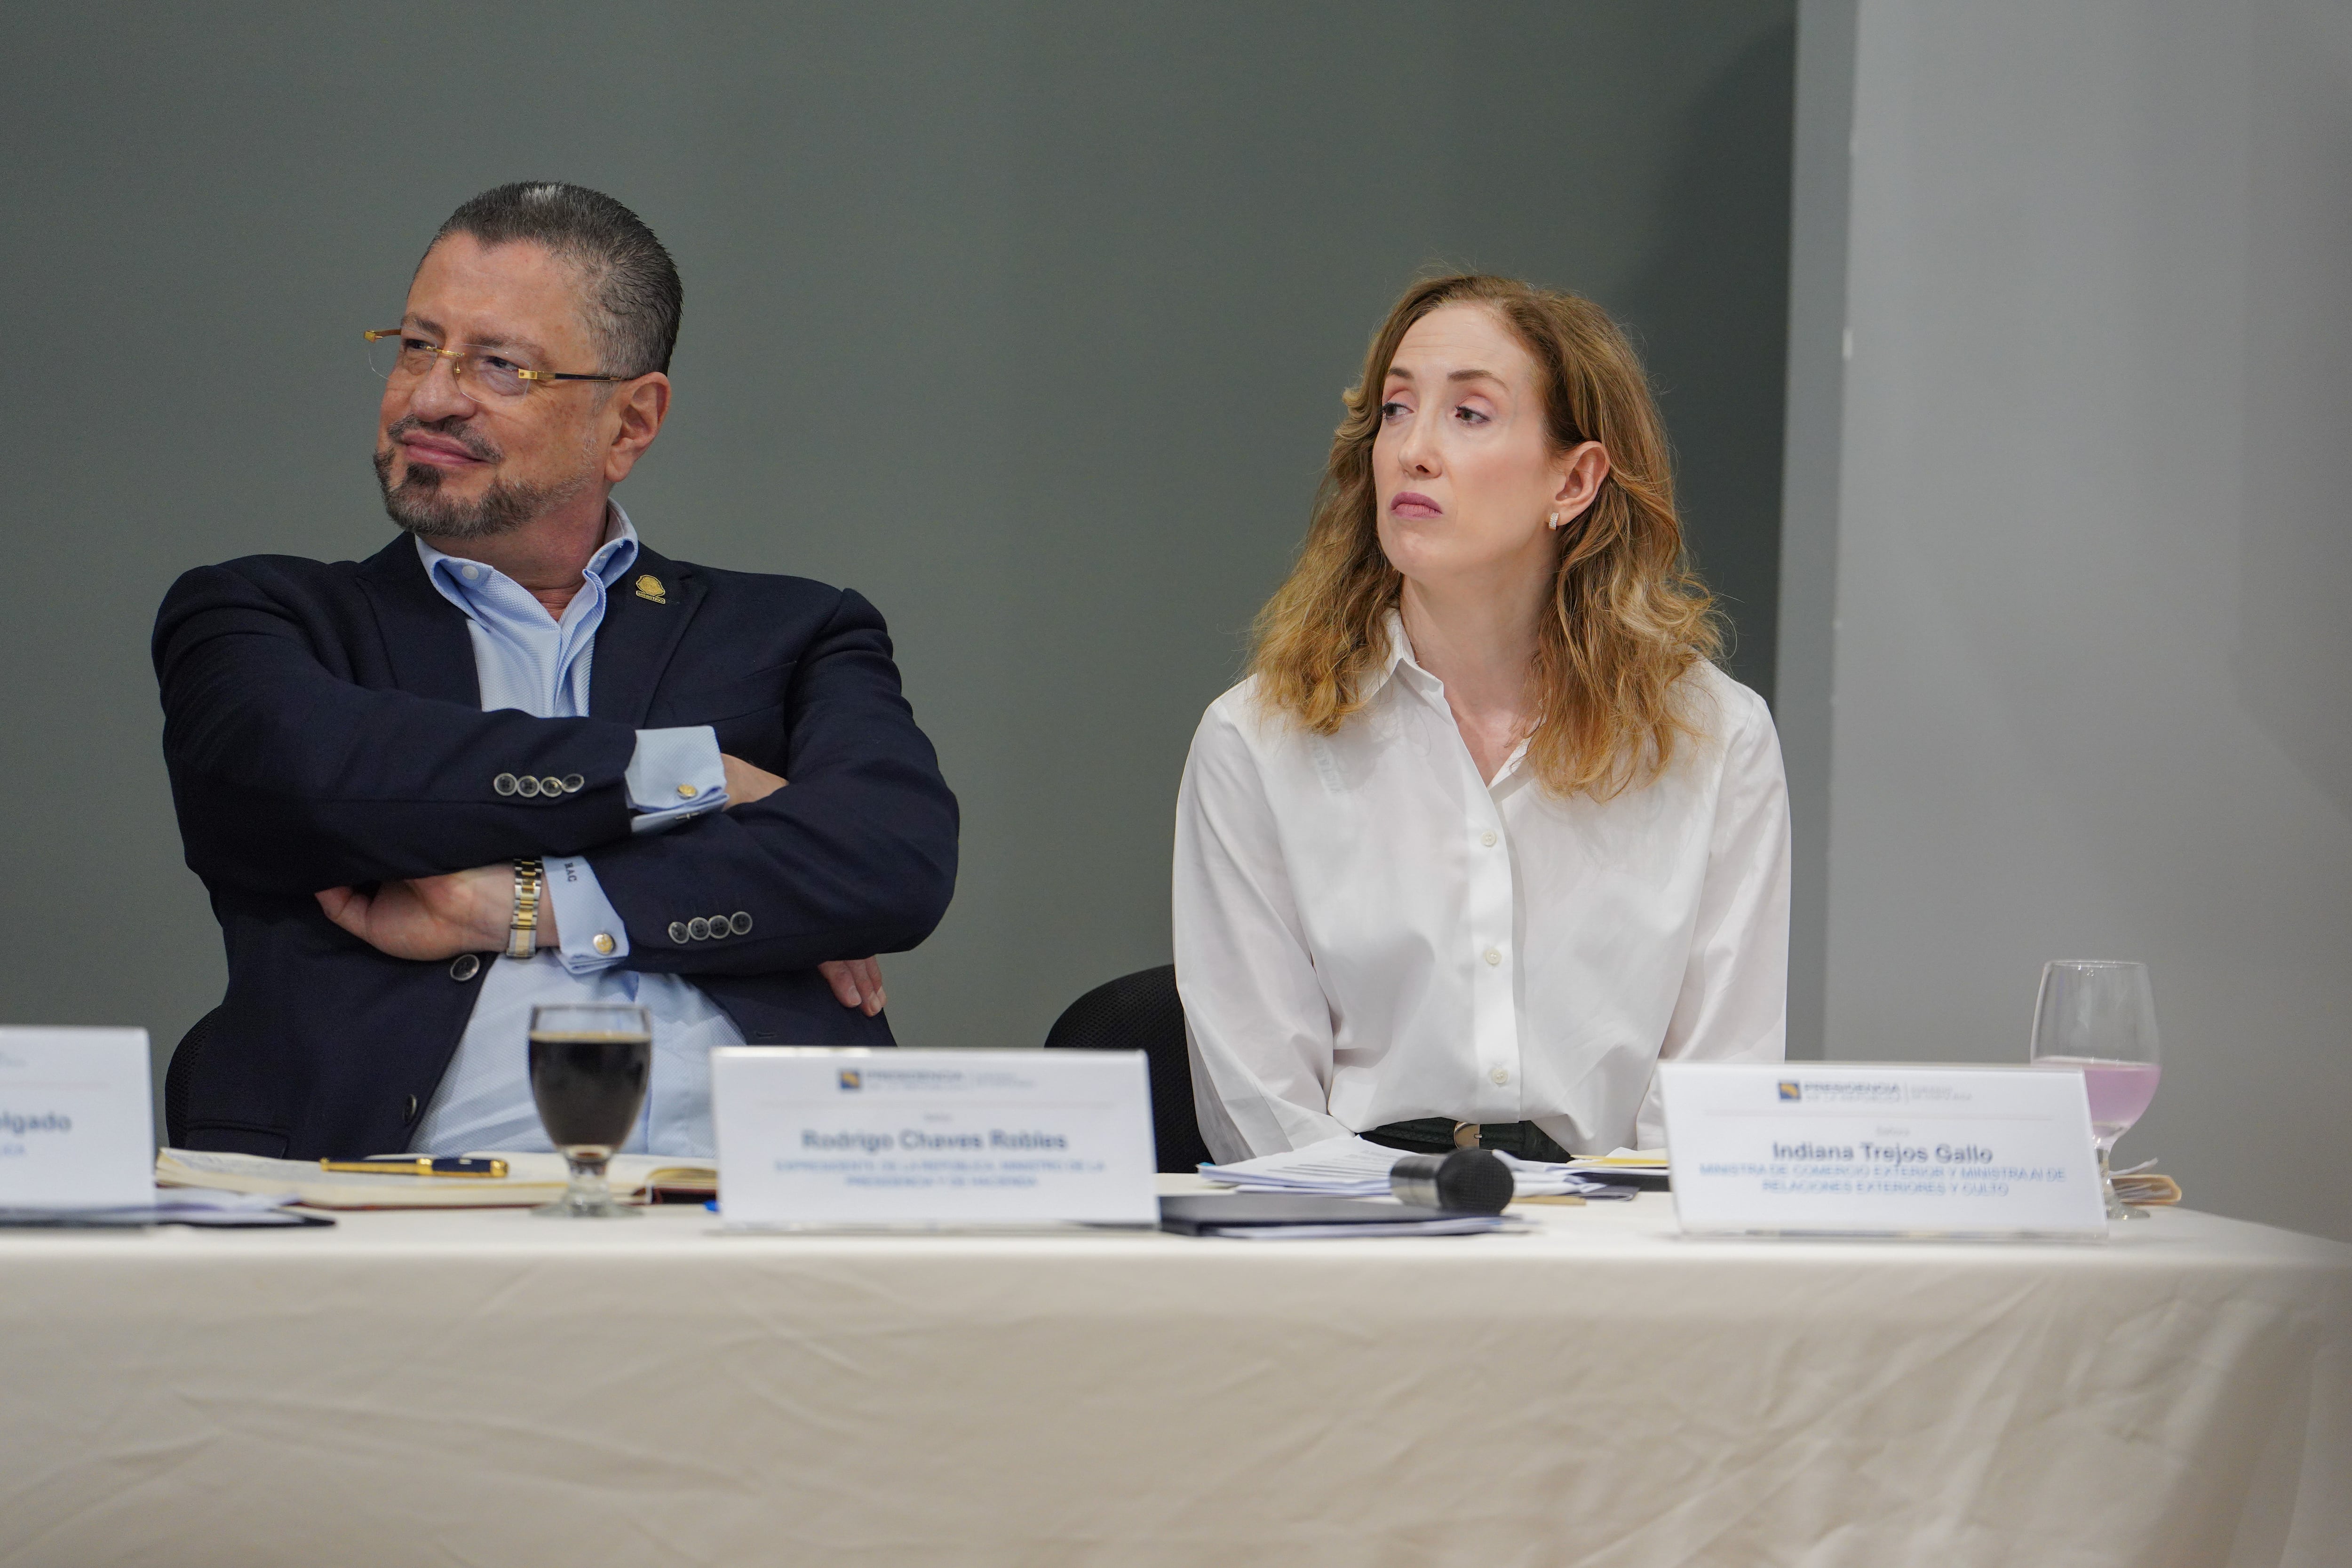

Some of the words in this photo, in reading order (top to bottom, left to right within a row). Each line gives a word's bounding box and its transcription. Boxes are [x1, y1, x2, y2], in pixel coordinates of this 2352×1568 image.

[638, 592, 663, 603] MINISTRO
[1804, 1081, 1900, 1093] PRESIDENCIA
[0, 1109, 72, 1136] lgado
[802, 1130, 894, 1155] Rodrigo
[898, 1129, 983, 1151] Chaves
[988, 1130, 1069, 1151] Robles
[1773, 1141, 1854, 1161] Indiana
[1859, 1141, 1929, 1167] Trejos
[1934, 1142, 1993, 1163] Gallo
[1699, 1163, 1765, 1176] MINISTRA
[1768, 1164, 1787, 1177] DE
[1792, 1164, 1871, 1178] COMERCIO
[1874, 1166, 1945, 1180] EXTERIOR
[1949, 1167, 1958, 1180] Y
[1962, 1167, 2028, 1182] MINISTRA
[2046, 1170, 2066, 1183] DE
[1762, 1179, 1852, 1195] RELACIONES
[1856, 1180, 1947, 1196] EXTERIORES
[1950, 1182, 1959, 1195] Y
[1962, 1182, 2010, 1197] CULTO
